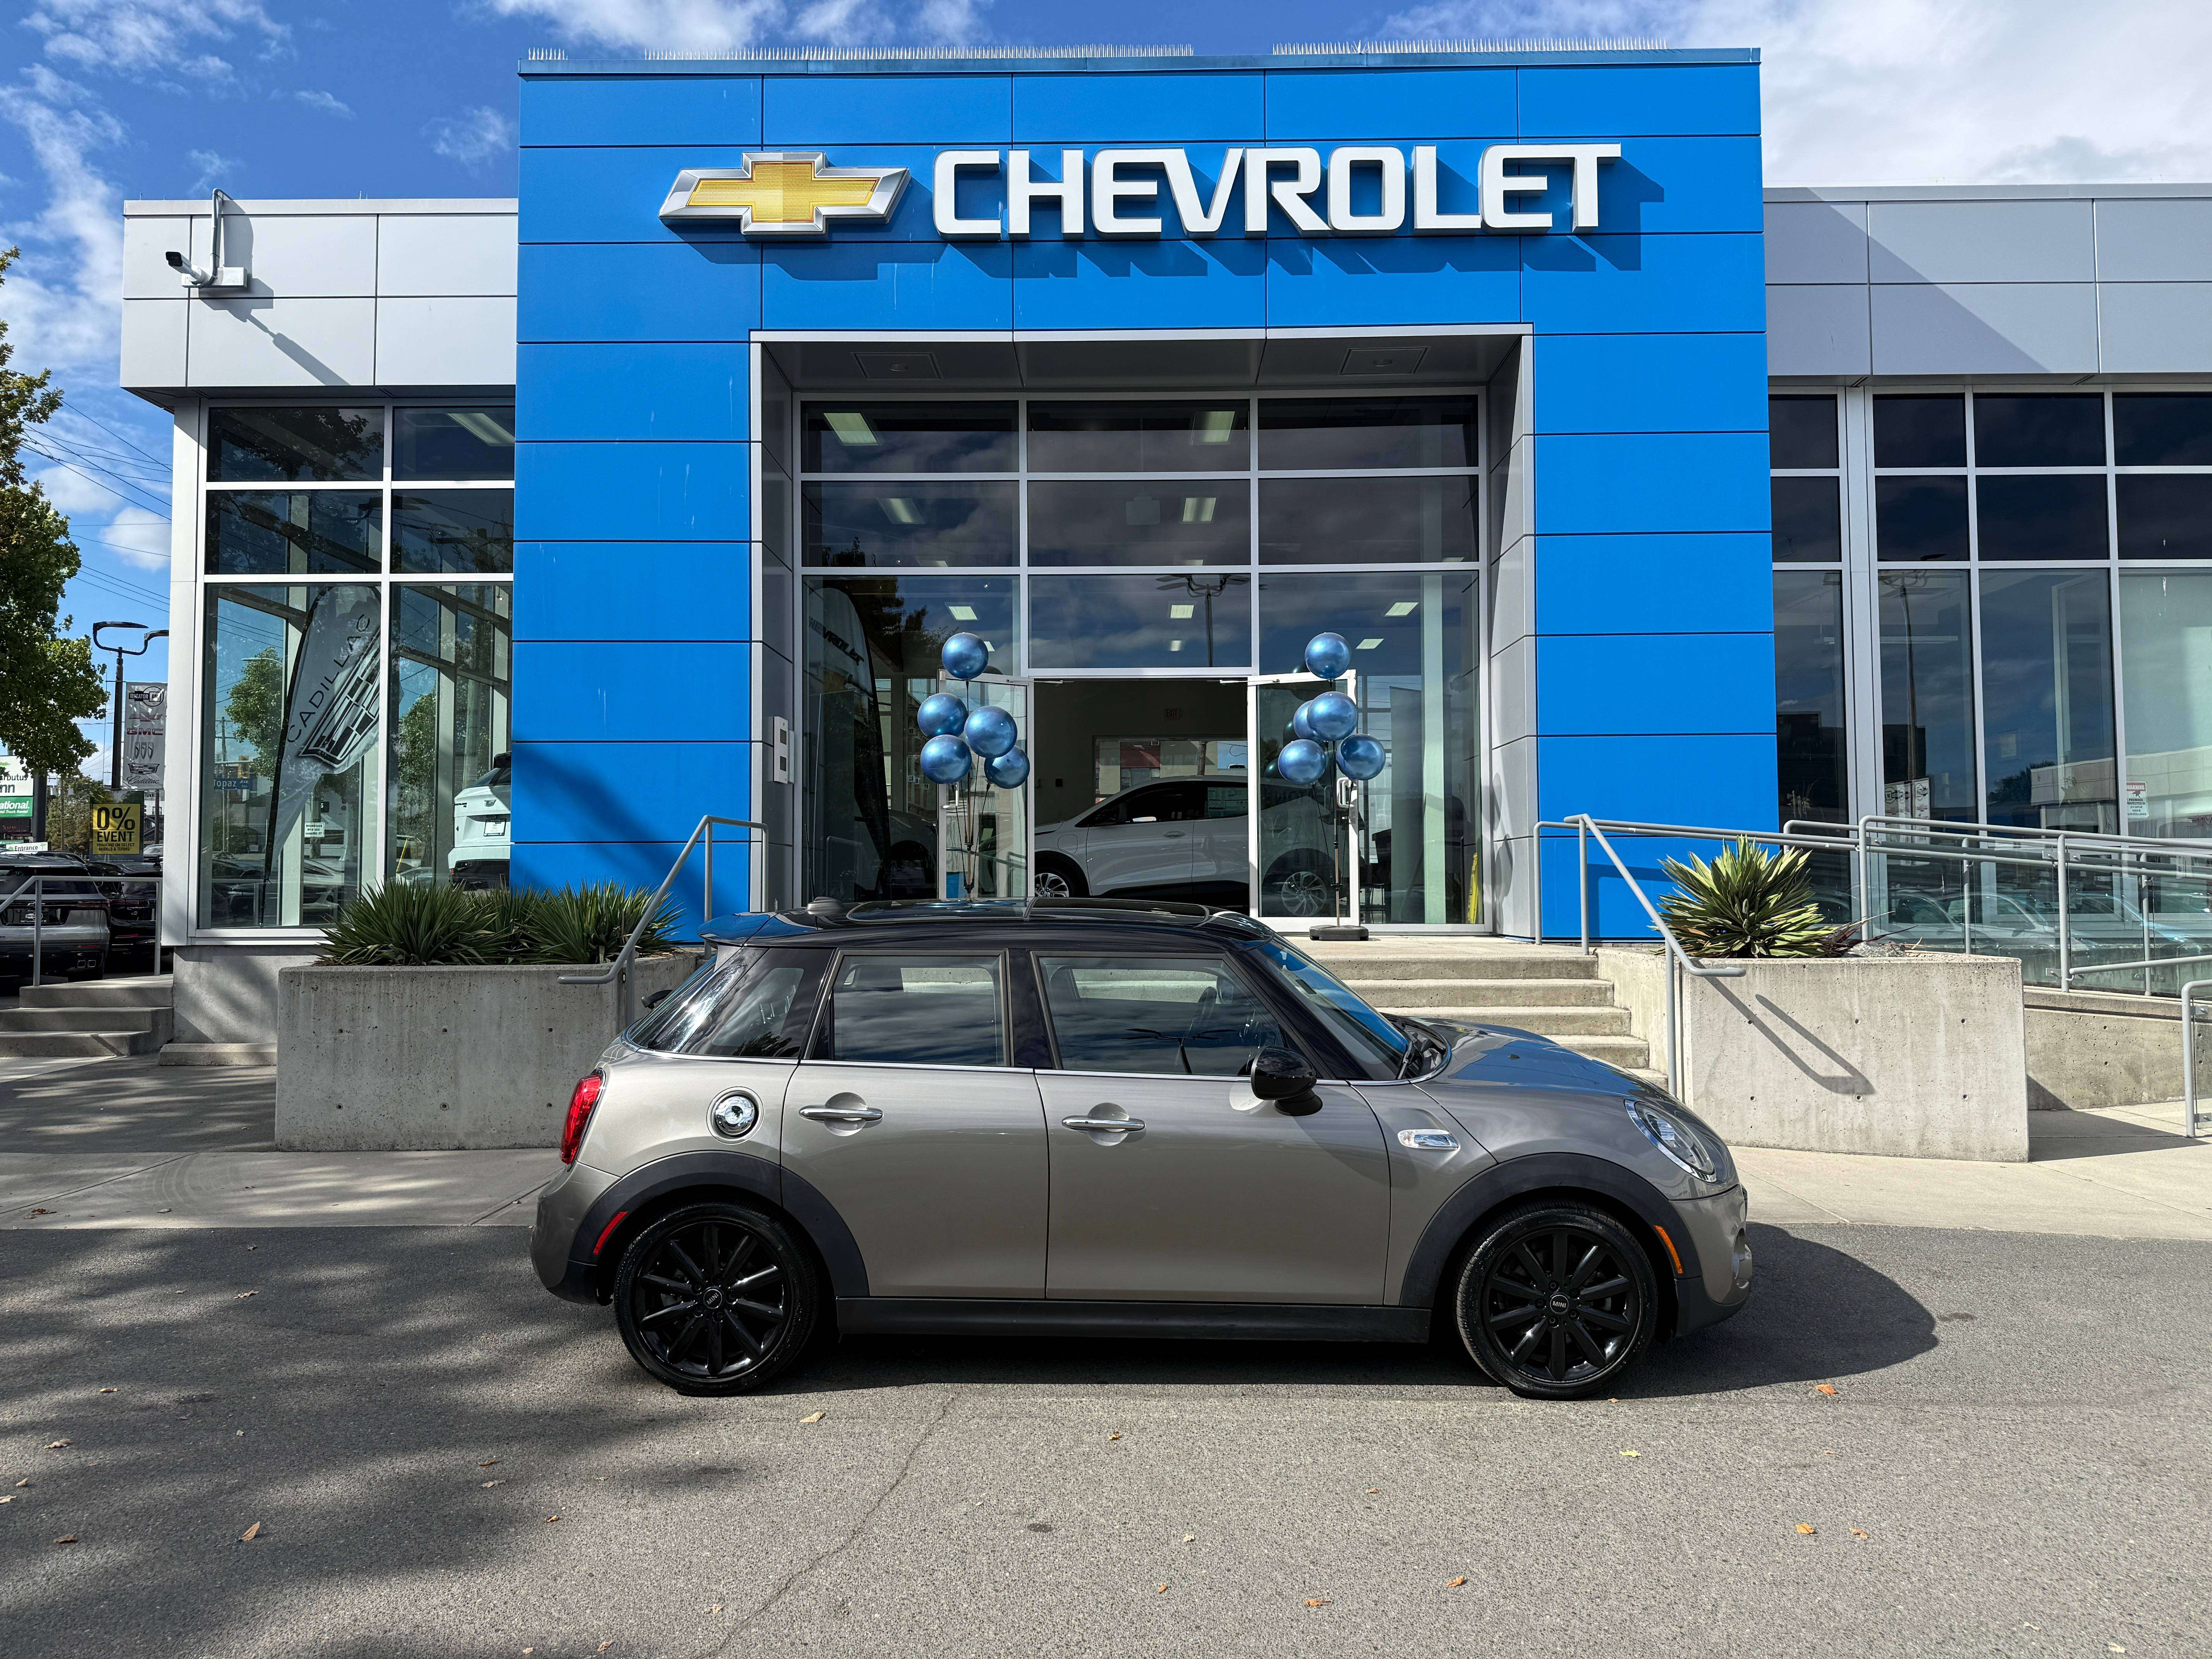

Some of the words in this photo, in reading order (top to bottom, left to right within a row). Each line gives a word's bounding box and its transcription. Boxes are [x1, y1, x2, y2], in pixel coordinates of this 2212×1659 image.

[933, 142, 1621, 238] CHEVROLET
[287, 614, 370, 743] CADILLAC
[127, 776, 159, 785] Cadillac
[214, 780, 236, 789] Topaz
[0, 784, 15, 793] nn
[0, 800, 30, 809] ational.
[97, 807, 135, 830] 0%
[97, 831, 134, 842] EVENT
[706, 1293, 719, 1305] MINI
